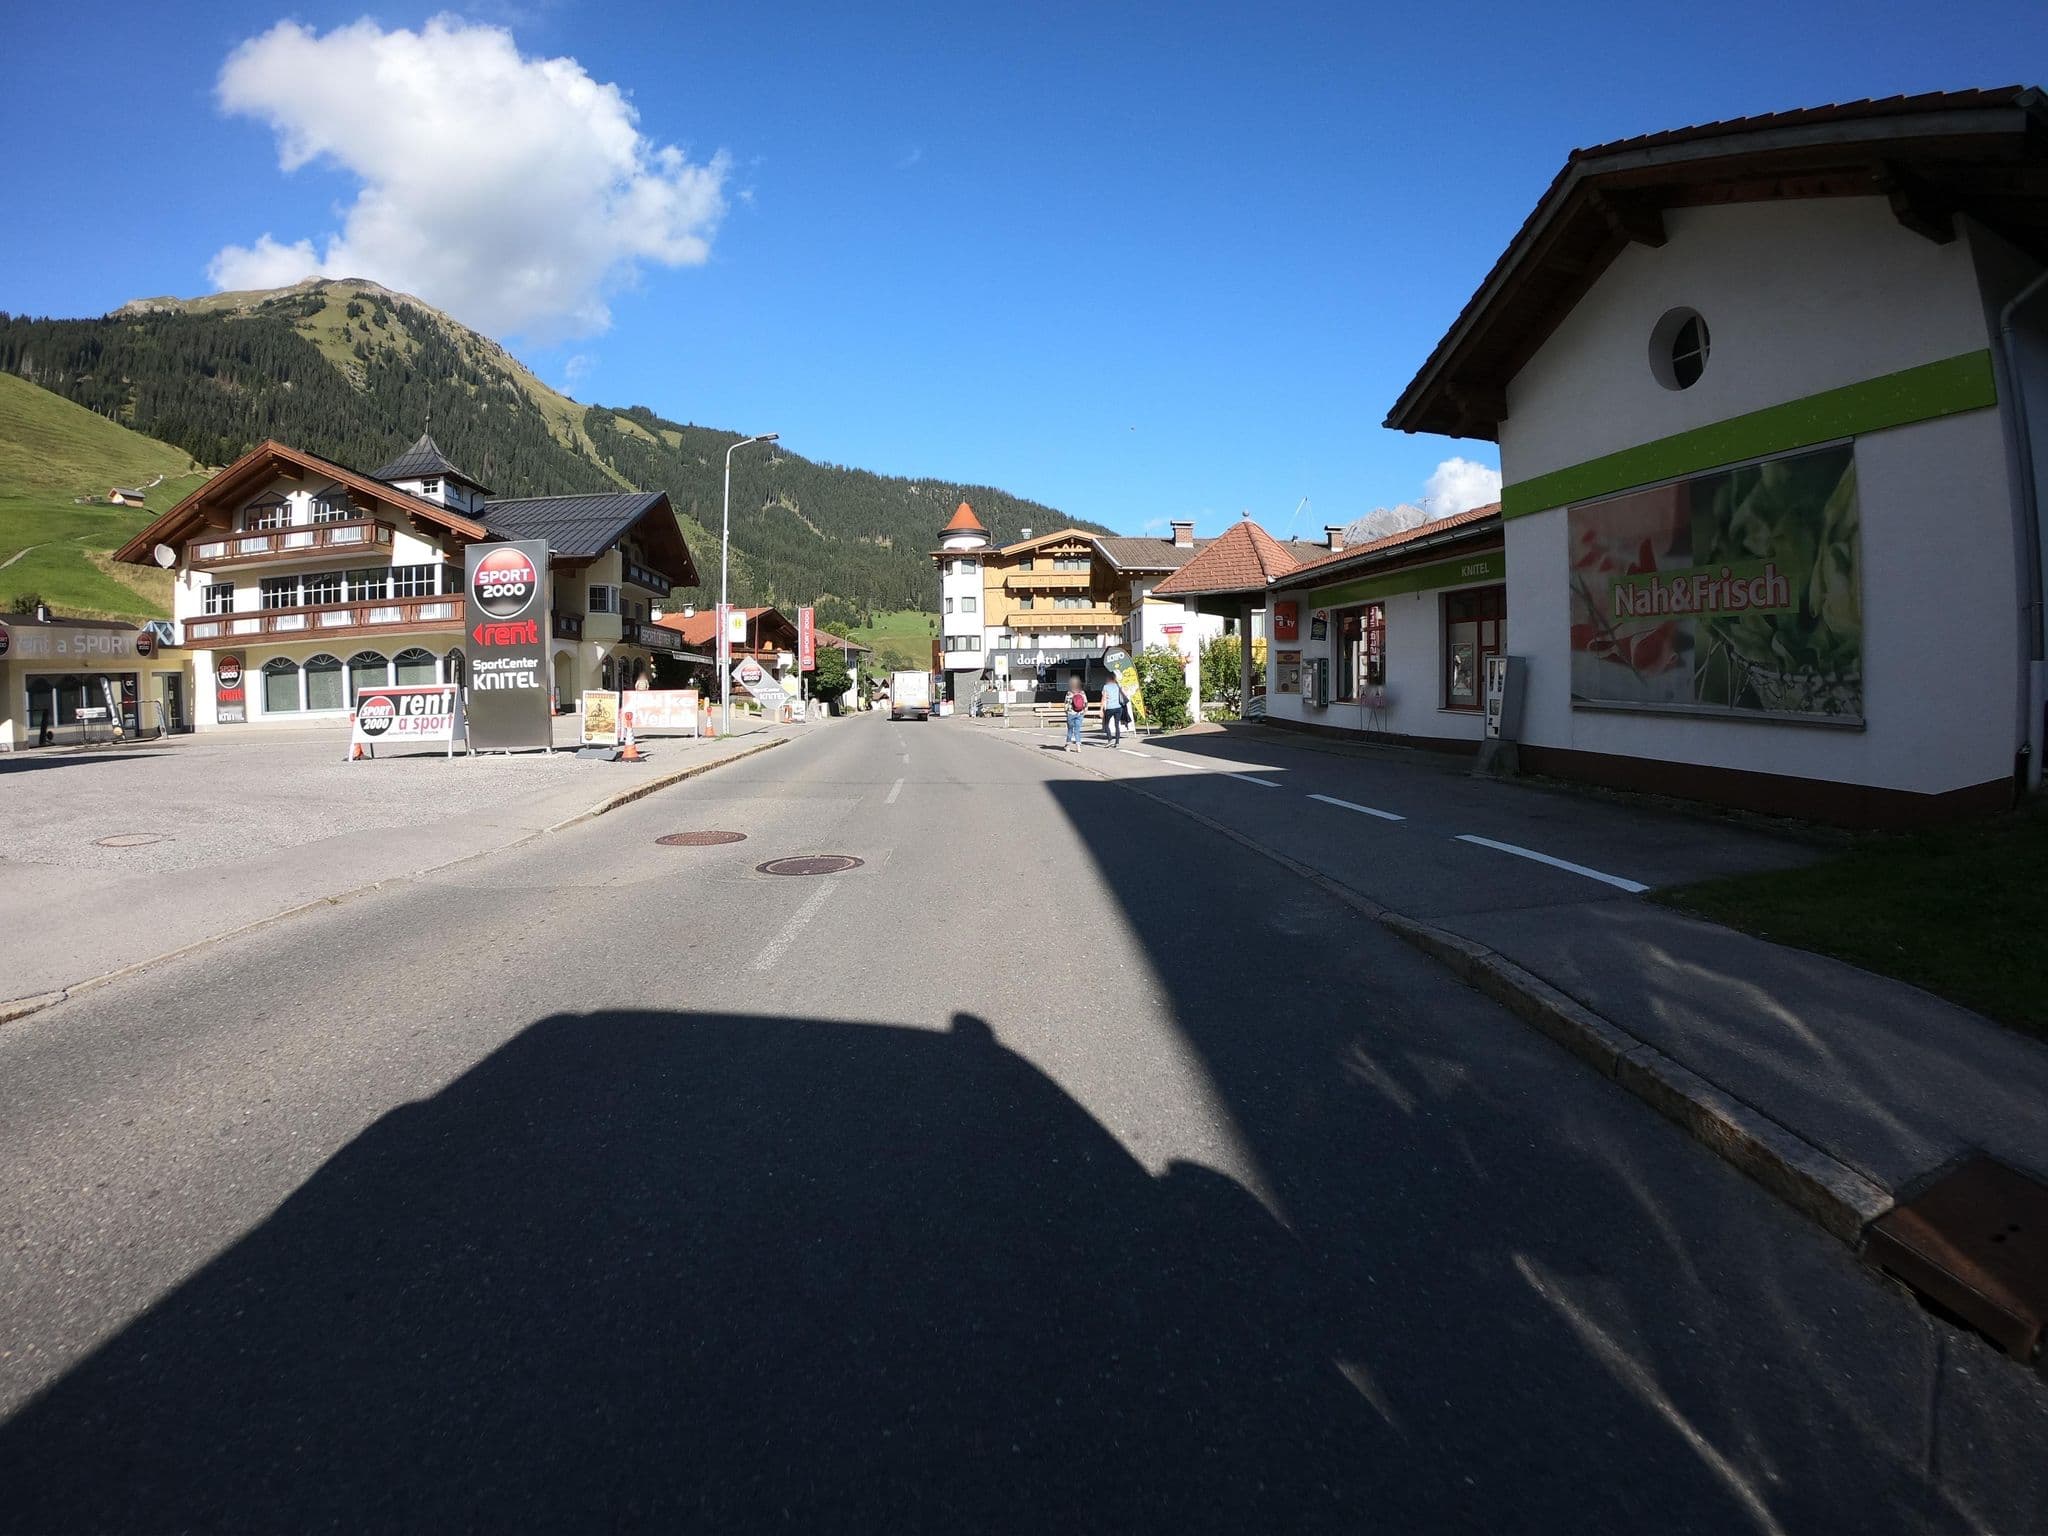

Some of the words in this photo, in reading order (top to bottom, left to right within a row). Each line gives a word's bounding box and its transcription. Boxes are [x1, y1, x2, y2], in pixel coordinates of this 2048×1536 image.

[478, 568, 530, 584] SPORT
[1461, 561, 1490, 577] KNITEL
[483, 583, 526, 598] 2000
[1614, 562, 1791, 619] Nah&Frisch
[484, 620, 539, 646] rent
[74, 635, 131, 655] SPORT
[220, 665, 240, 673] SPORT
[473, 658, 538, 672] SportCenter
[221, 671, 238, 680] 2000
[473, 671, 540, 691] KNITEL
[400, 689, 452, 716] rent
[362, 706, 393, 717] SPORT
[363, 718, 390, 730] 2000
[399, 717, 407, 730] a
[413, 713, 453, 735] sport
